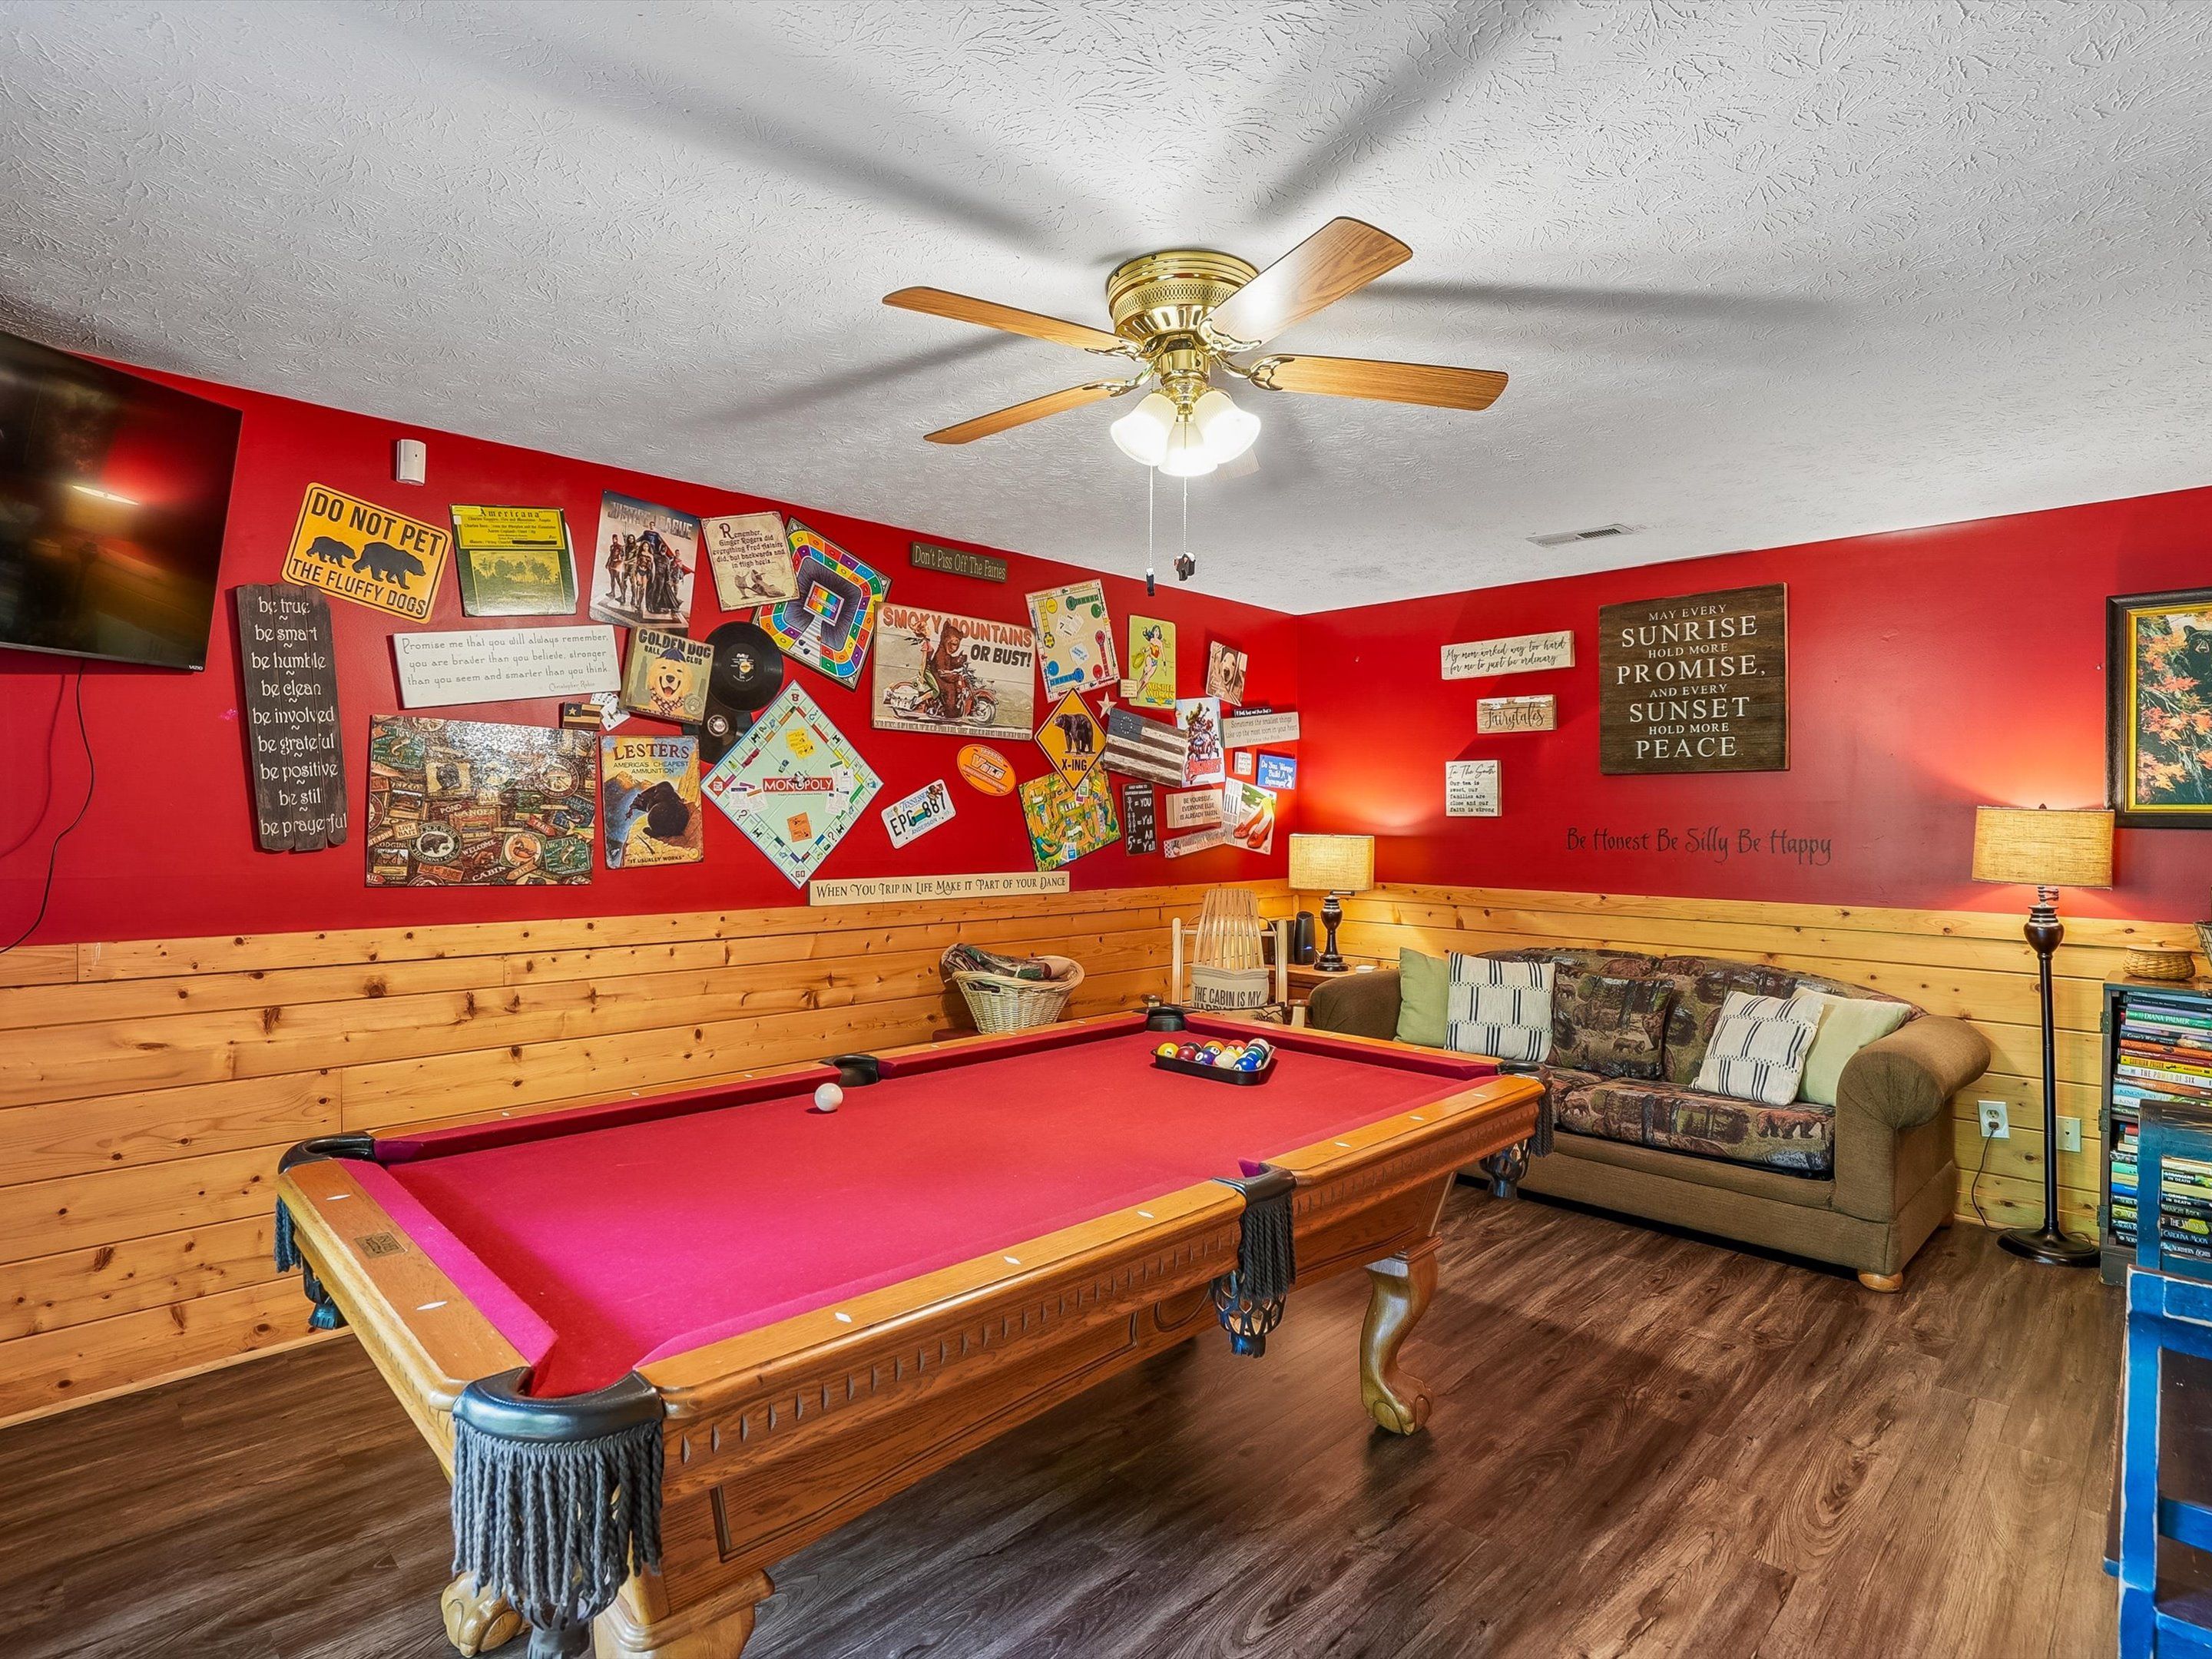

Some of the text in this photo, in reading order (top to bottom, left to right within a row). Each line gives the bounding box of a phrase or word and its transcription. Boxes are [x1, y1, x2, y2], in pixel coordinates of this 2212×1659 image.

[480, 508, 540, 518] Americana
[311, 492, 345, 523] DO
[349, 506, 397, 540] NOT
[399, 524, 442, 556] PET
[713, 546, 745, 556] everything
[719, 538, 740, 547] Ginger
[915, 545, 1006, 580] Don't Piss Off The Fairies
[293, 558, 427, 615] THE FLUFFY DOGS
[259, 596, 311, 615] be true
[1648, 604, 1727, 622] MAY EVERY
[255, 624, 318, 642] be smart
[882, 607, 1032, 649] SMOKY MOUNTAINS
[1621, 615, 1758, 648] SUNRISE
[402, 638, 445, 654] Promise
[467, 634, 486, 648] that
[488, 636, 506, 651] you
[509, 633, 525, 647] will
[528, 630, 560, 649] always
[562, 630, 609, 644] remember,
[638, 629, 711, 659] GOLDEN DOG
[644, 645, 661, 657] BALL
[1445, 649, 1460, 662] My
[1481, 644, 1507, 657] worked
[1511, 646, 1526, 657] way
[1528, 640, 1541, 651] too
[1544, 637, 1566, 650] hard
[1647, 643, 1728, 659] HOLD MORE
[251, 651, 326, 671] be humble
[409, 659, 428, 673] you
[432, 658, 449, 667] are
[452, 653, 485, 667] braver
[488, 650, 509, 664] than
[512, 654, 529, 667] you
[569, 650, 607, 664] stronger
[686, 656, 702, 665] CLUB
[970, 644, 1032, 667] OR BUST!
[1450, 663, 1462, 675] for
[1477, 660, 1485, 669] to
[1486, 657, 1505, 672] just
[1508, 656, 1518, 667] be
[1521, 653, 1557, 666] ordinary
[407, 675, 430, 687] than
[434, 675, 452, 689] you
[455, 674, 482, 683] seem
[484, 667, 502, 681] and
[505, 666, 543, 680] smarter
[546, 665, 565, 677] than
[568, 667, 584, 681] you
[1616, 654, 1766, 685] PROMISE,
[261, 679, 322, 697] be clean
[1649, 684, 1727, 698] AND EVERY
[253, 705, 335, 726] be involved
[1483, 702, 1545, 730] Fairytales
[1629, 696, 1750, 724] SUNSET
[1648, 723, 1729, 736] HOLD MORE
[258, 735, 277, 753] be
[612, 743, 690, 761] LESTERS
[1635, 736, 1744, 760] PEACE.
[260, 761, 339, 783] be positive
[1061, 759, 1088, 771] X-ING
[1448, 765, 1458, 779] In
[1460, 765, 1473, 778] The
[763, 778, 833, 792] MONOPOLY
[440, 804, 462, 815] POND
[1141, 797, 1152, 806] YOU
[1182, 804, 1204, 813] EVERYONE
[261, 814, 348, 837] be prayerful
[912, 818, 938, 835] ANDERSON
[462, 839, 497, 856] WELCOME
[1566, 826, 1832, 866] Be Honest Be Silly Be Happy
[472, 866, 506, 882] CABIN
[795, 869, 806, 878] GO
[816, 876, 1067, 898] WHEN YOU TRIP IN LIFE MAKE IT PART OF YOUR DANCE
[1194, 985, 1207, 1002] THE
[1209, 988, 1235, 1007] CABIN
[1237, 991, 1245, 1007] IS
[1247, 991, 1262, 1006] MY
[2144, 1012, 2190, 1025] DIANA PALMER
[2184, 1075, 2195, 1084] SIX
[2163, 1230, 2208, 1244] CAROLINA MOON
